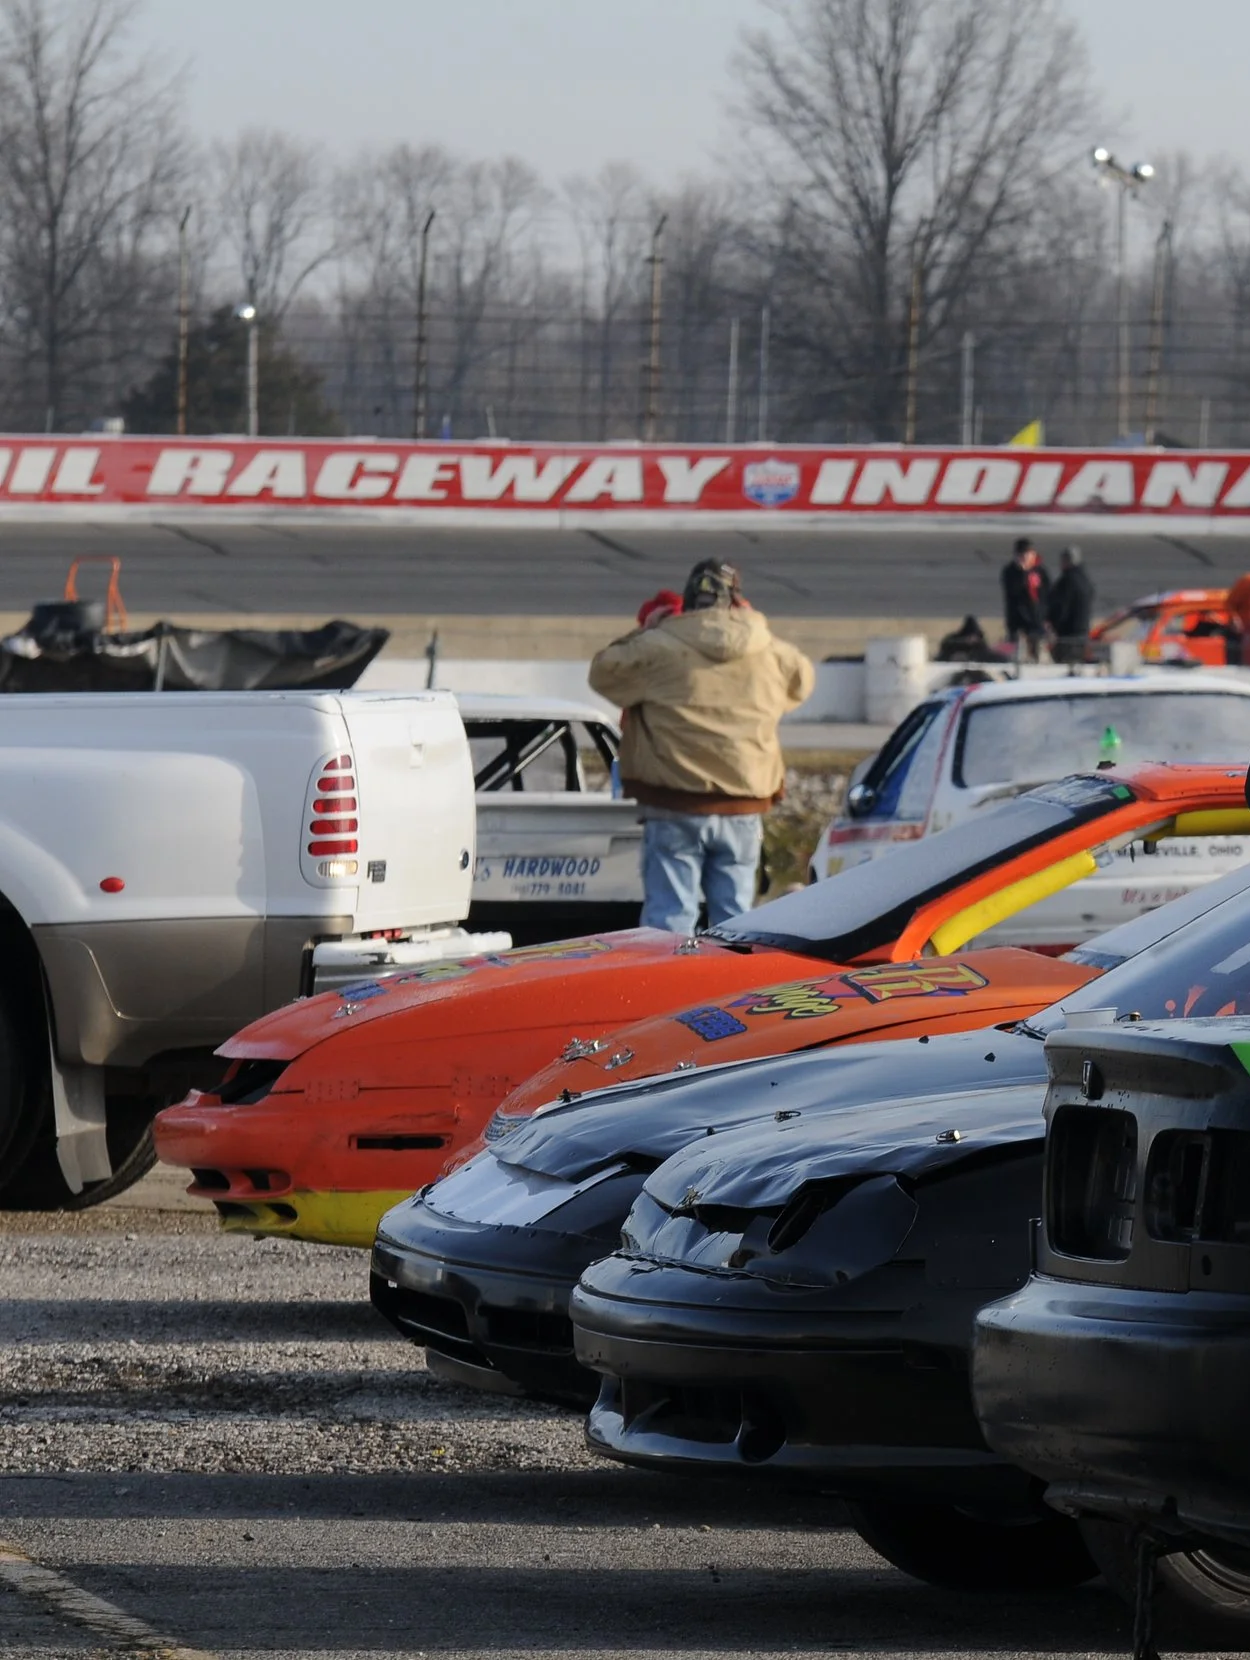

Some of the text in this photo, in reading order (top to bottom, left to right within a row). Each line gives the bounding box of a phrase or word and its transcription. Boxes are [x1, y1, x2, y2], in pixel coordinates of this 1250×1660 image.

[0, 446, 107, 494] IL
[146, 448, 732, 504] RACEWAY
[1208, 845, 1243, 857] OHIO
[503, 857, 601, 877] HARDWOOD
